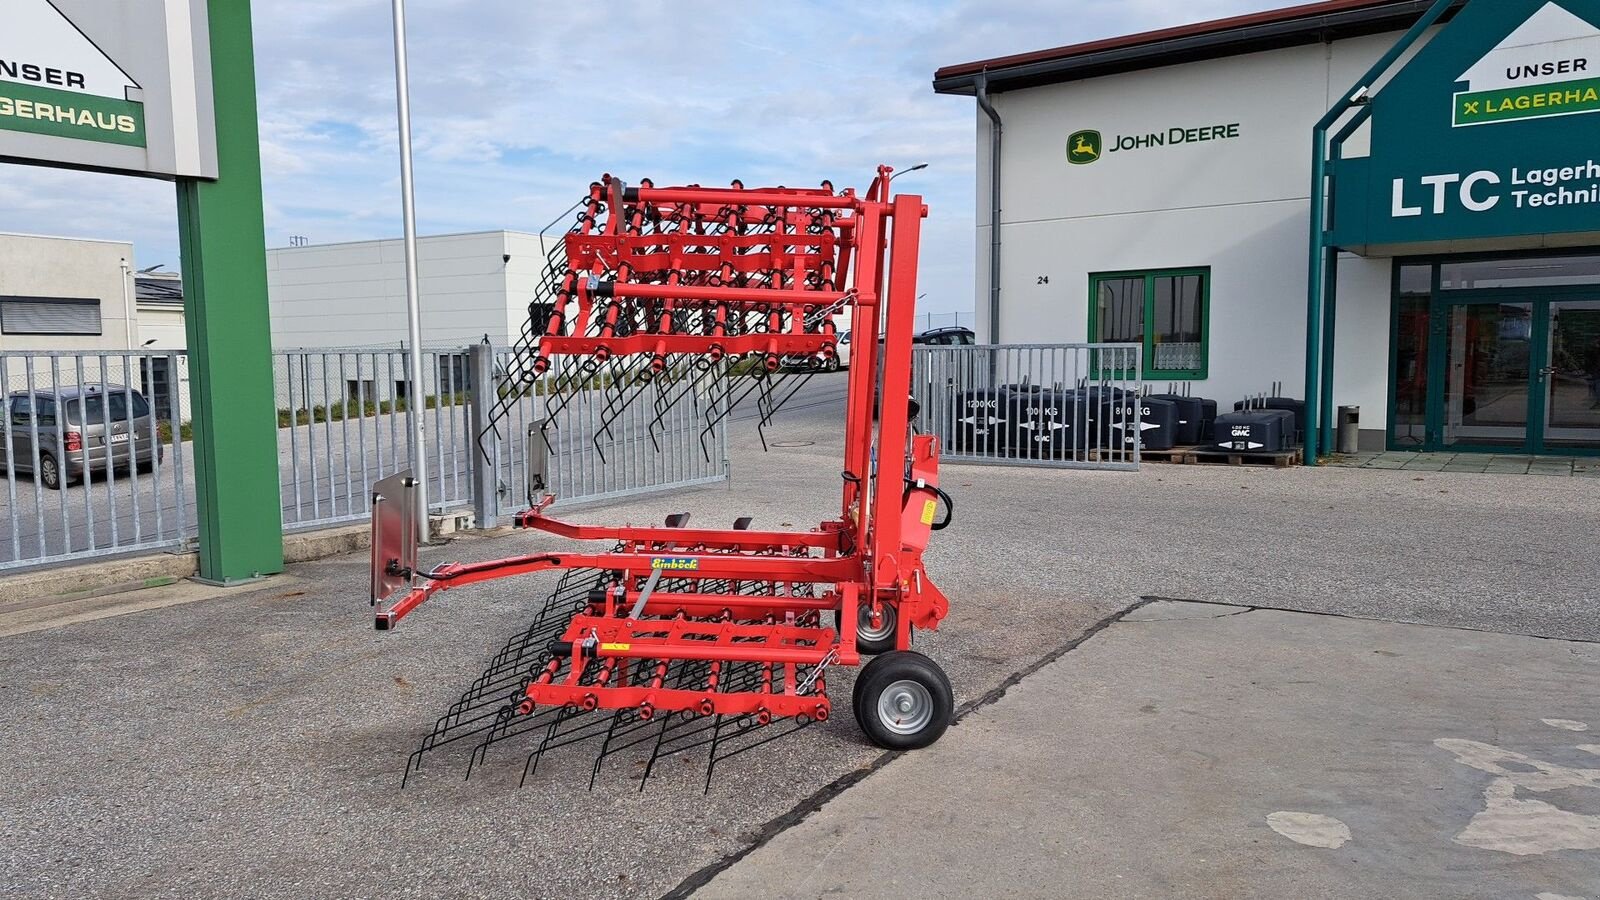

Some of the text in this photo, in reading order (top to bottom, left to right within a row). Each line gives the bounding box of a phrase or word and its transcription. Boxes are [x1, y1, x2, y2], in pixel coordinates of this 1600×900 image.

[1506, 58, 1587, 80] UNSER
[1486, 87, 1598, 113] LAGERHA
[1109, 123, 1240, 152] JOHN DEERE
[1391, 170, 1501, 217] LTC
[1511, 184, 1600, 208] Techni
[1037, 275, 1049, 285] 24
[1025, 407, 1058, 416] 100 KG
[651, 558, 697, 569] Einböck
